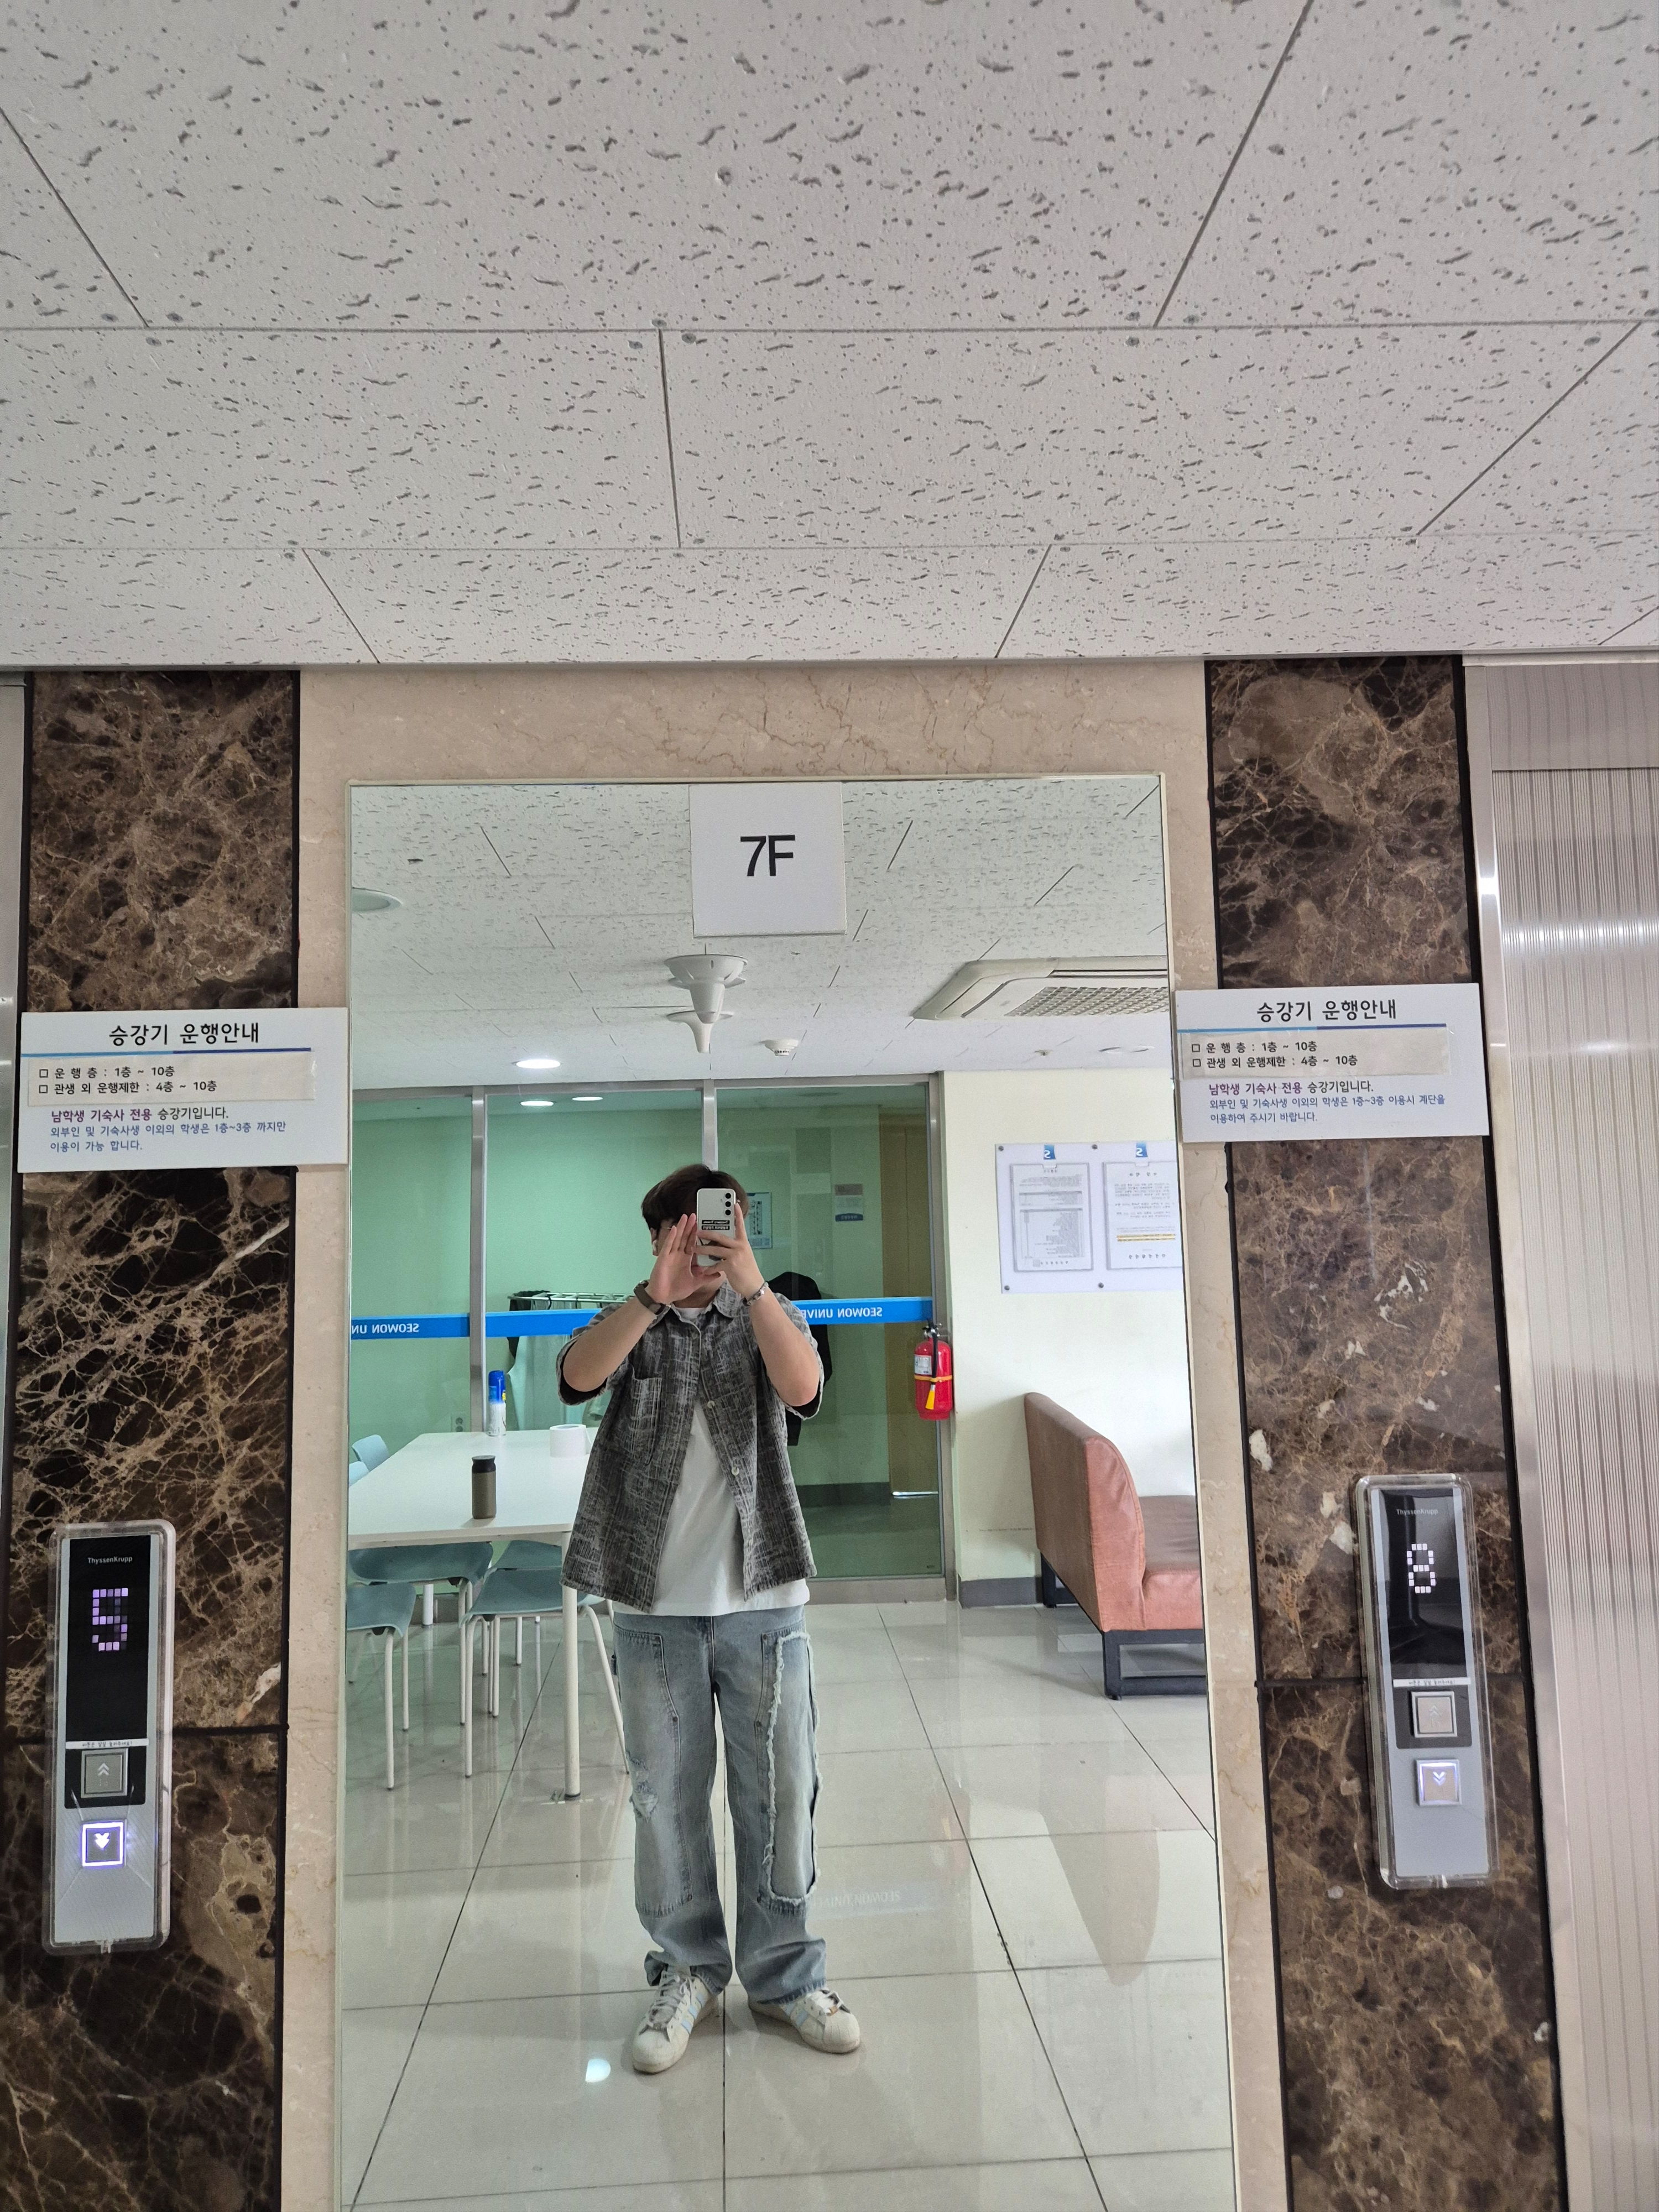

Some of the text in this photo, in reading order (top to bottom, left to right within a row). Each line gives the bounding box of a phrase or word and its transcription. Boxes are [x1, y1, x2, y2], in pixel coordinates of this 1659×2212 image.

[740, 834, 796, 877] 7F
[1257, 999, 1396, 1022] 승강기 운행안내
[109, 1022, 259, 1046] 승강기 운행안내
[1206, 1042, 1216, 1053] 운
[1220, 1042, 1230, 1053] 행
[1236, 1042, 1246, 1053] 층
[1261, 1041, 1277, 1052] 1층
[1295, 1041, 1317, 1052] 10층
[1206, 1057, 1226, 1068] 관생
[1232, 1057, 1241, 1068] 외
[1246, 1056, 1286, 1068] 운행제한
[1301, 1055, 1317, 1067] 4층
[1335, 1055, 1358, 1066] 10층
[55, 1068, 65, 1078] 운
[71, 1067, 81, 1078] 행
[87, 1067, 97, 1078] 층
[114, 1066, 131, 1078] 1층
[152, 1066, 175, 1077] 10층
[54, 1083, 75, 1094] 관생
[81, 1083, 91, 1094] 외
[97, 1081, 139, 1093] 운행제한
[155, 1081, 174, 1093] 4층
[193, 1080, 217, 1092] 10층
[1209, 1080, 1374, 1096] 남학생 기숙사 전용 승강기입니다.
[1209, 1093, 1445, 1110] 외부인 및 기숙사생 이외의 학생은 1층~3층 이용시 계단을
[51, 1107, 229, 1123] 남학생 기숙사 전용 승강기입니다.
[1211, 1112, 1317, 1124] 이용하여 주시기 바랍니다.
[50, 1121, 286, 1138] 외부인 및 기숙사생 이외의 학생은 1층~3층 까지만
[50, 1140, 143, 1152] 이용이 가능 합니다.
[87, 1556, 133, 1565] ThyssenKrupp
[1406, 1543, 1436, 1594] 8
[92, 1588, 128, 1652] 5
